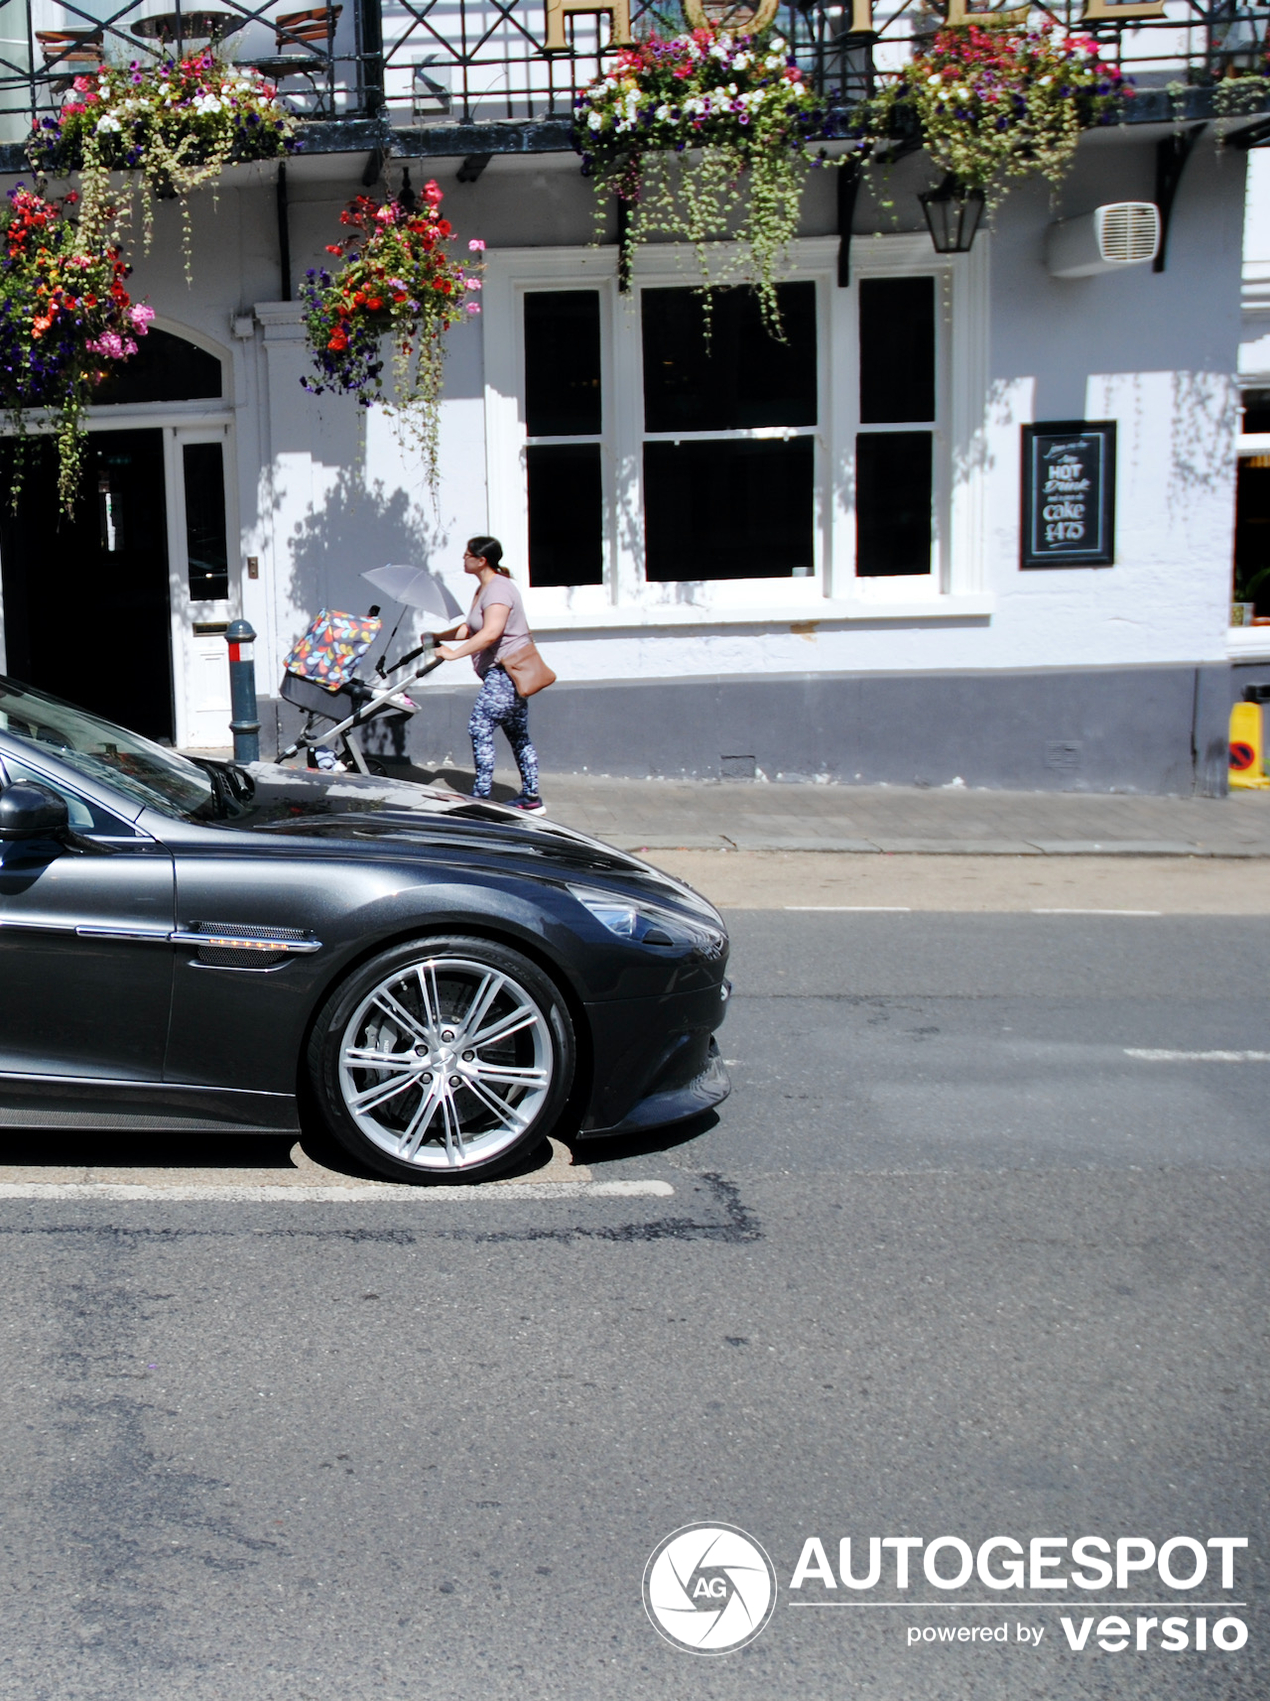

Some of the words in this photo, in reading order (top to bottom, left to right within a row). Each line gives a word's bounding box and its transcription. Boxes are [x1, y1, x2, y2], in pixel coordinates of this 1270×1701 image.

[1049, 464, 1083, 480] HOT
[1042, 479, 1092, 494] Drink
[1043, 501, 1086, 521] cake
